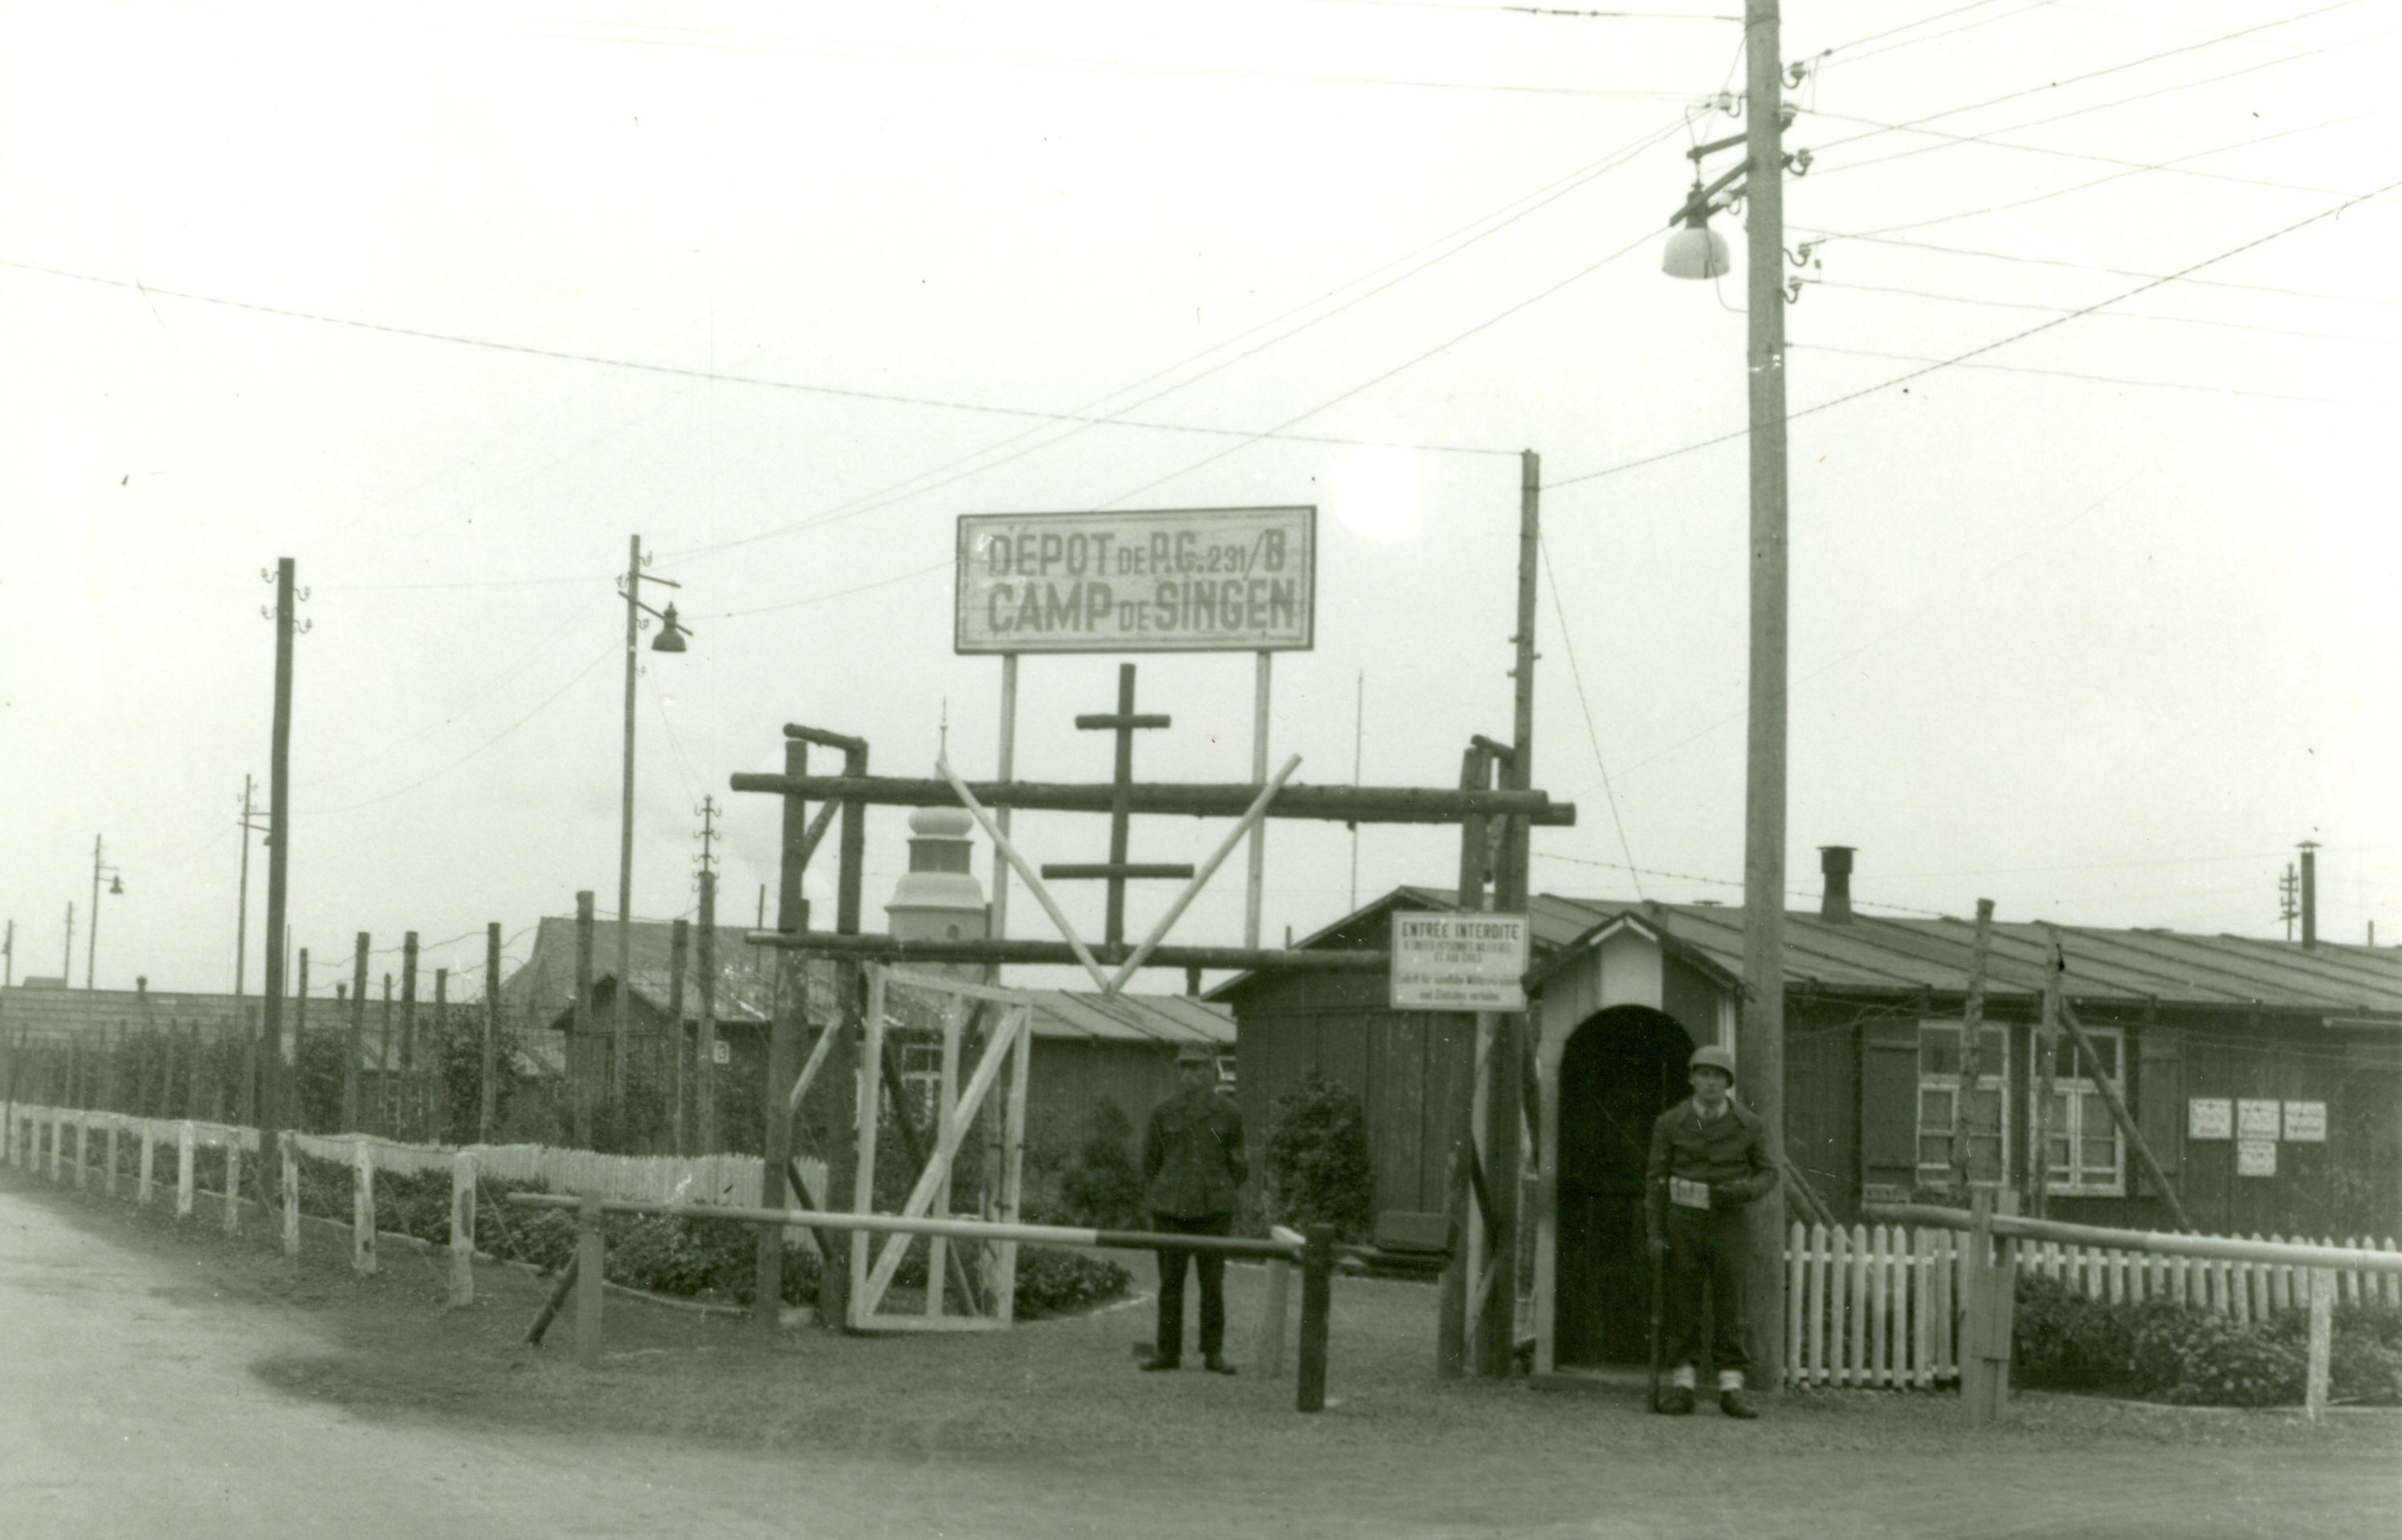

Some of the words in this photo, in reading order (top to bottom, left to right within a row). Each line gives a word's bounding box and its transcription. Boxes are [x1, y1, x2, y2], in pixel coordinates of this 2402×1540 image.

[1117, 547, 1145, 576] DE
[987, 581, 1113, 633] CAMP
[1118, 601, 1150, 632] DE
[1154, 578, 1296, 632] SINGEN
[1455, 923, 1520, 940] INTERDITE
[718, 1044, 727, 1059] 3
